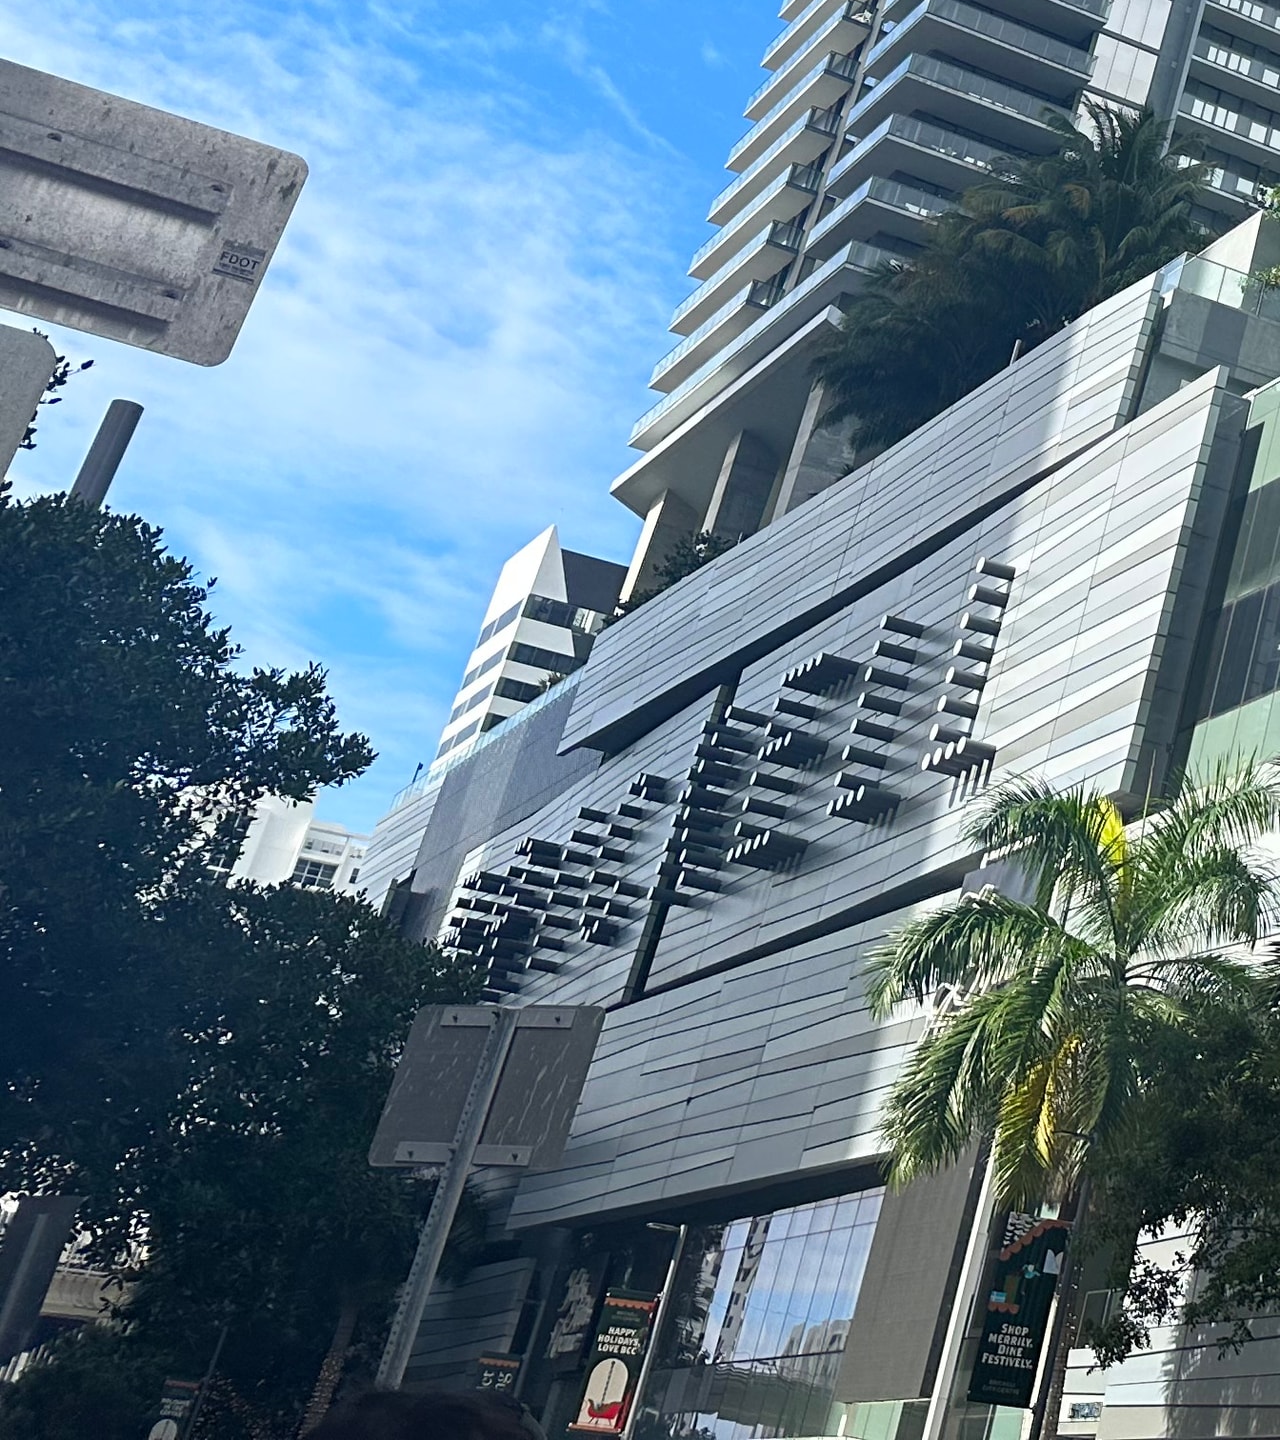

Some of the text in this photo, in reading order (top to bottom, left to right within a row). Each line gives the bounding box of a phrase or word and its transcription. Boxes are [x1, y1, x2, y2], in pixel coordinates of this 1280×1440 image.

[220, 250, 260, 270] FDOT
[608, 1326, 637, 1337] HAPPY
[1001, 1323, 1029, 1336] SHOP
[597, 1333, 641, 1348] HOLIDAYS,
[988, 1332, 1033, 1348] MERRILY.
[597, 1343, 637, 1355] LOVE BCC
[997, 1344, 1024, 1357] DINE
[981, 1352, 1033, 1369] FESTIVELY.
